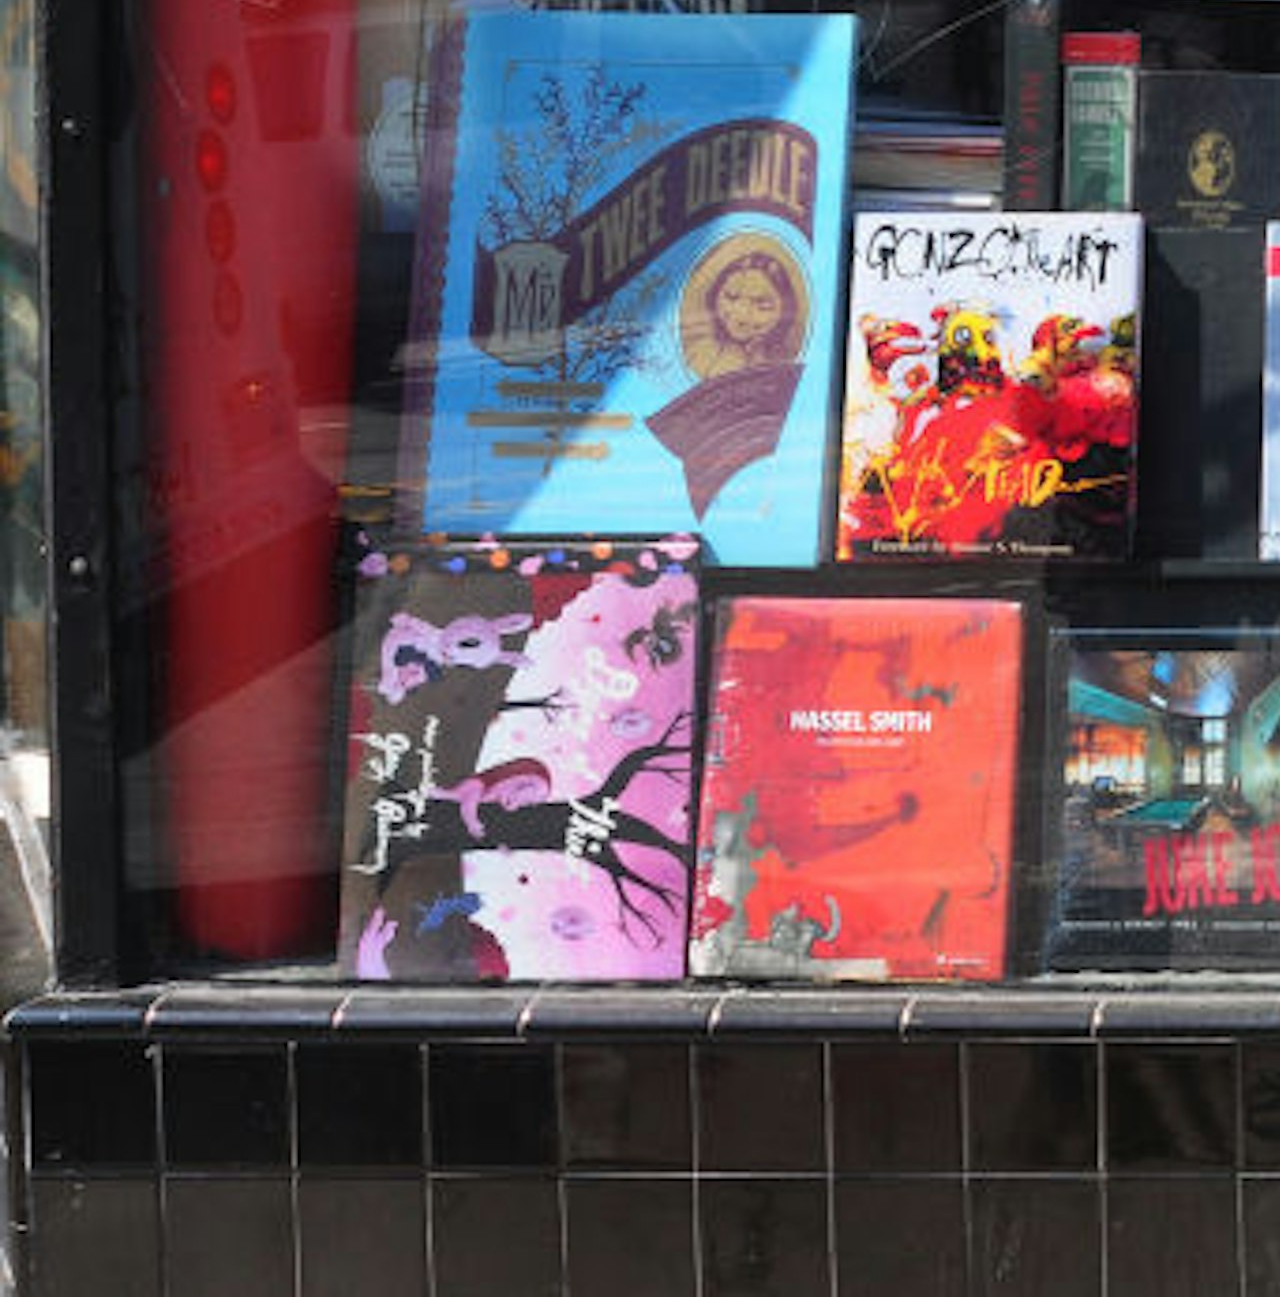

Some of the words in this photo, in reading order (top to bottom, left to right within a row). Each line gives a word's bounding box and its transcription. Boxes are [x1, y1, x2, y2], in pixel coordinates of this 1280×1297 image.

[578, 158, 668, 304] TWEE
[686, 129, 808, 222] DEEDLE
[788, 708, 866, 733] HASSEL
[868, 708, 933, 733] SMITH
[1142, 830, 1240, 916] JUKE
